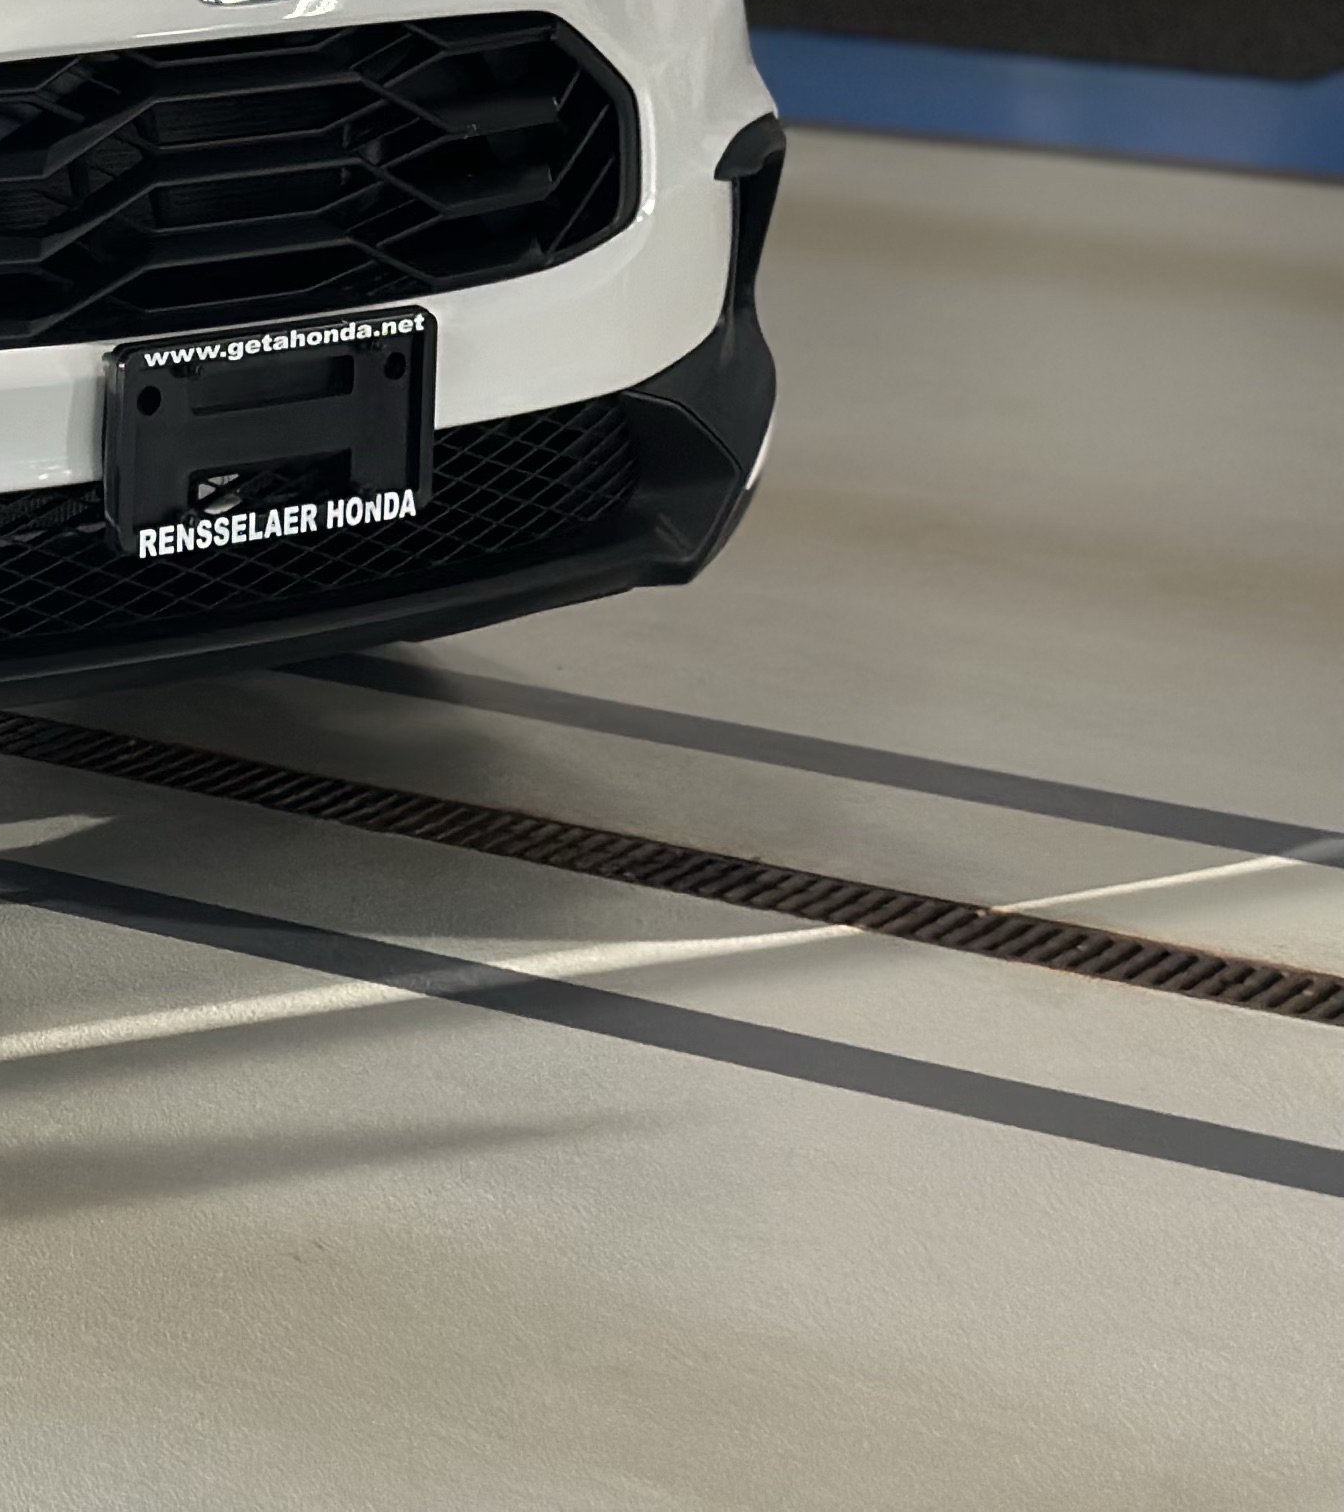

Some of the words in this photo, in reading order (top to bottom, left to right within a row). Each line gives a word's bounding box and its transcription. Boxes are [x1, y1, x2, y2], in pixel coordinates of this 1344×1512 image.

[143, 312, 425, 368] www.getahonda.net
[138, 503, 318, 559] RENSSELAER
[326, 488, 417, 529] HONDA
